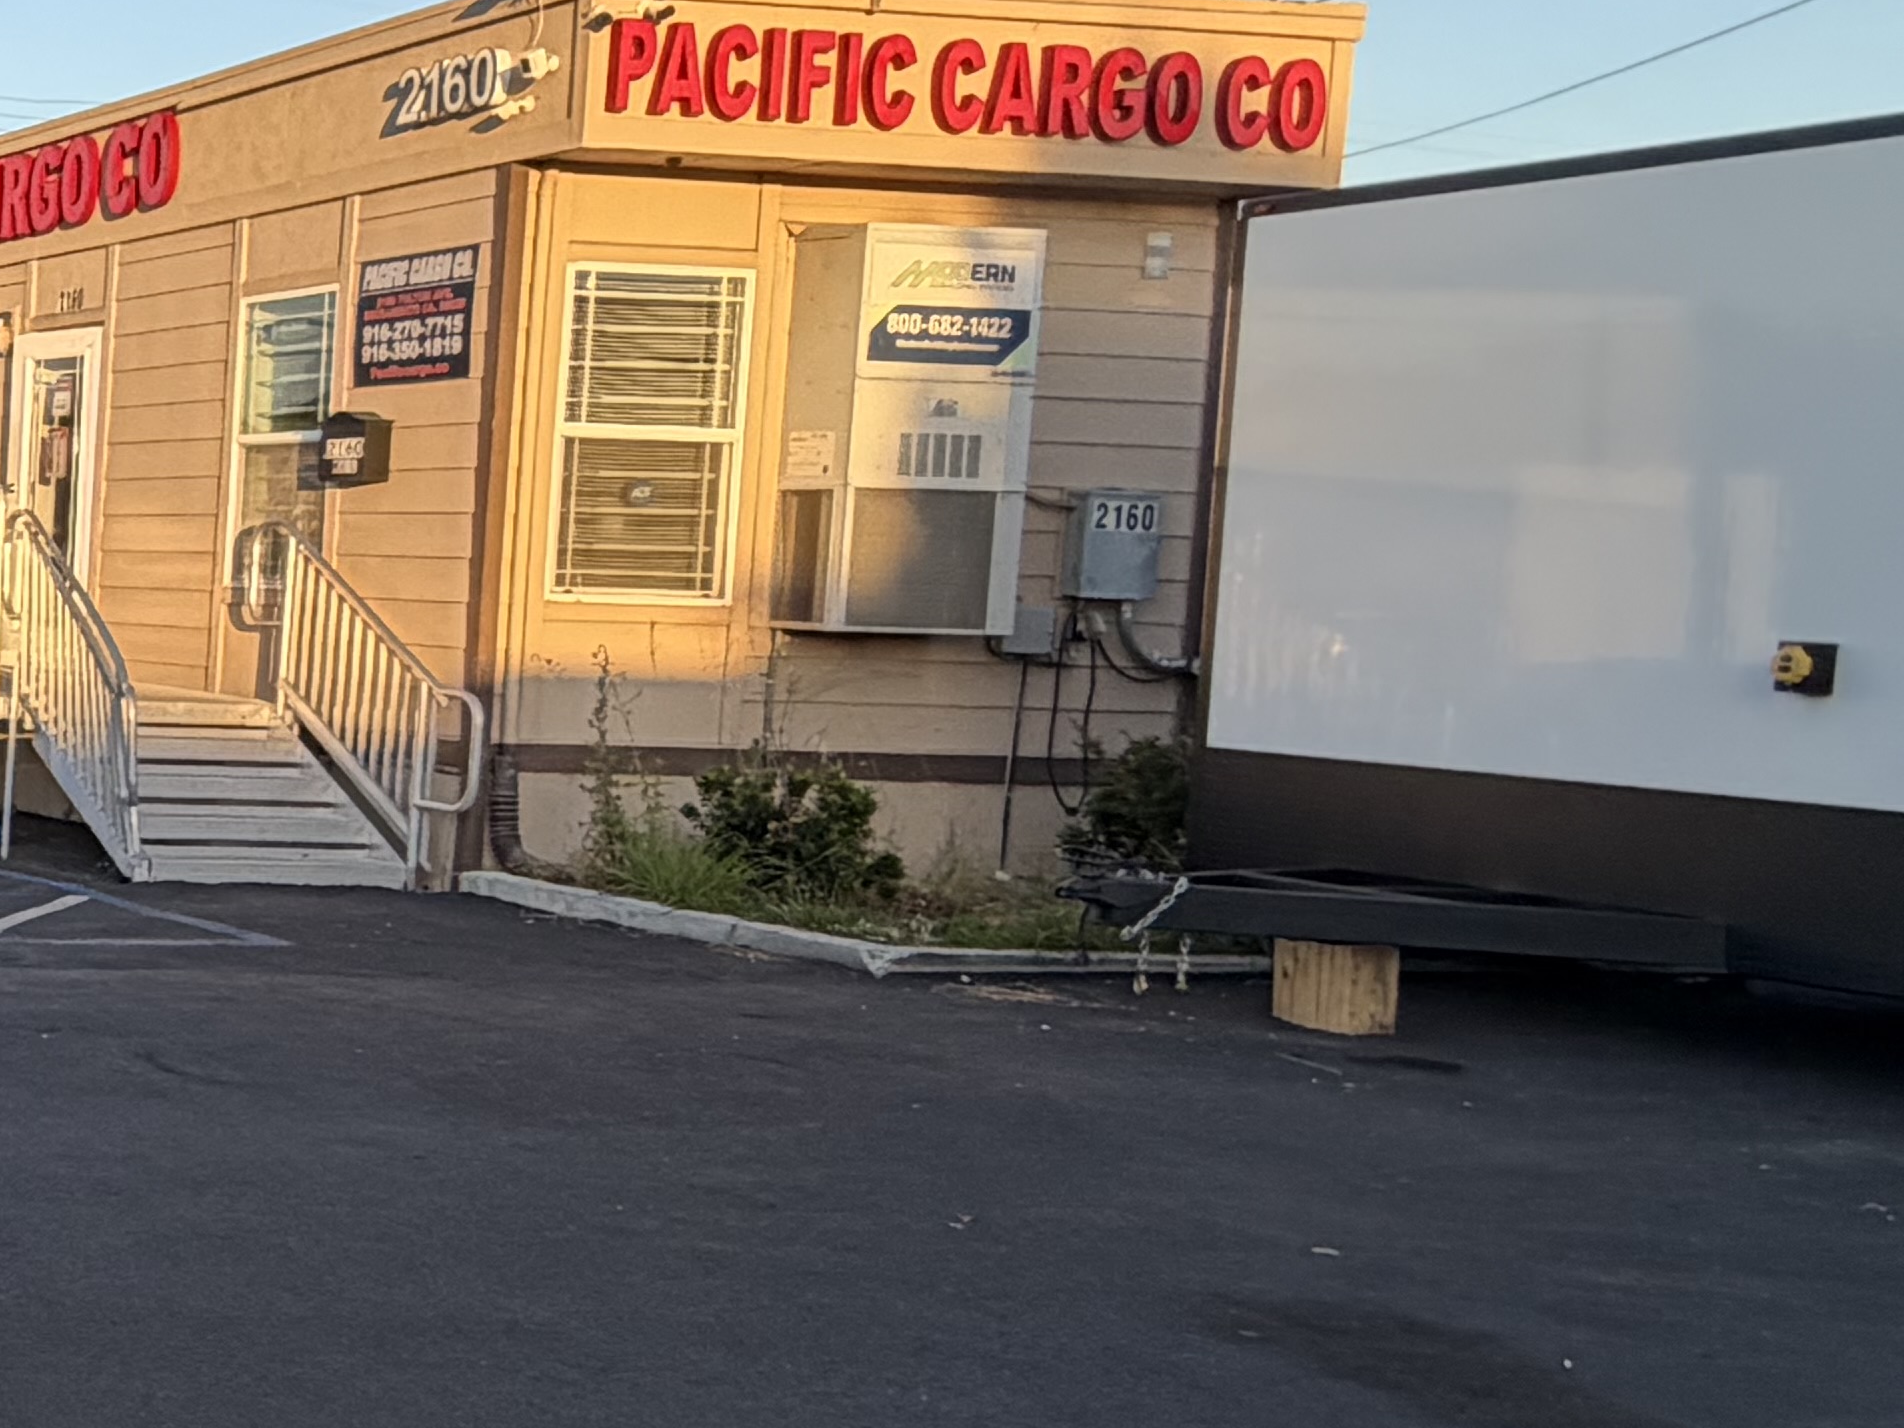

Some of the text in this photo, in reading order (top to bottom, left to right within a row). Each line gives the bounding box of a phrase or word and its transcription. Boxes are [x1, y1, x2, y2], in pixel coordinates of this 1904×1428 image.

[395, 47, 496, 126] 2160
[605, 18, 1327, 152] PACIFIC CARGO CO
[102, 111, 180, 217] CO
[891, 259, 1016, 288] MODERN
[886, 312, 1013, 339] 800-682-1422
[1094, 502, 1155, 532] 2160
